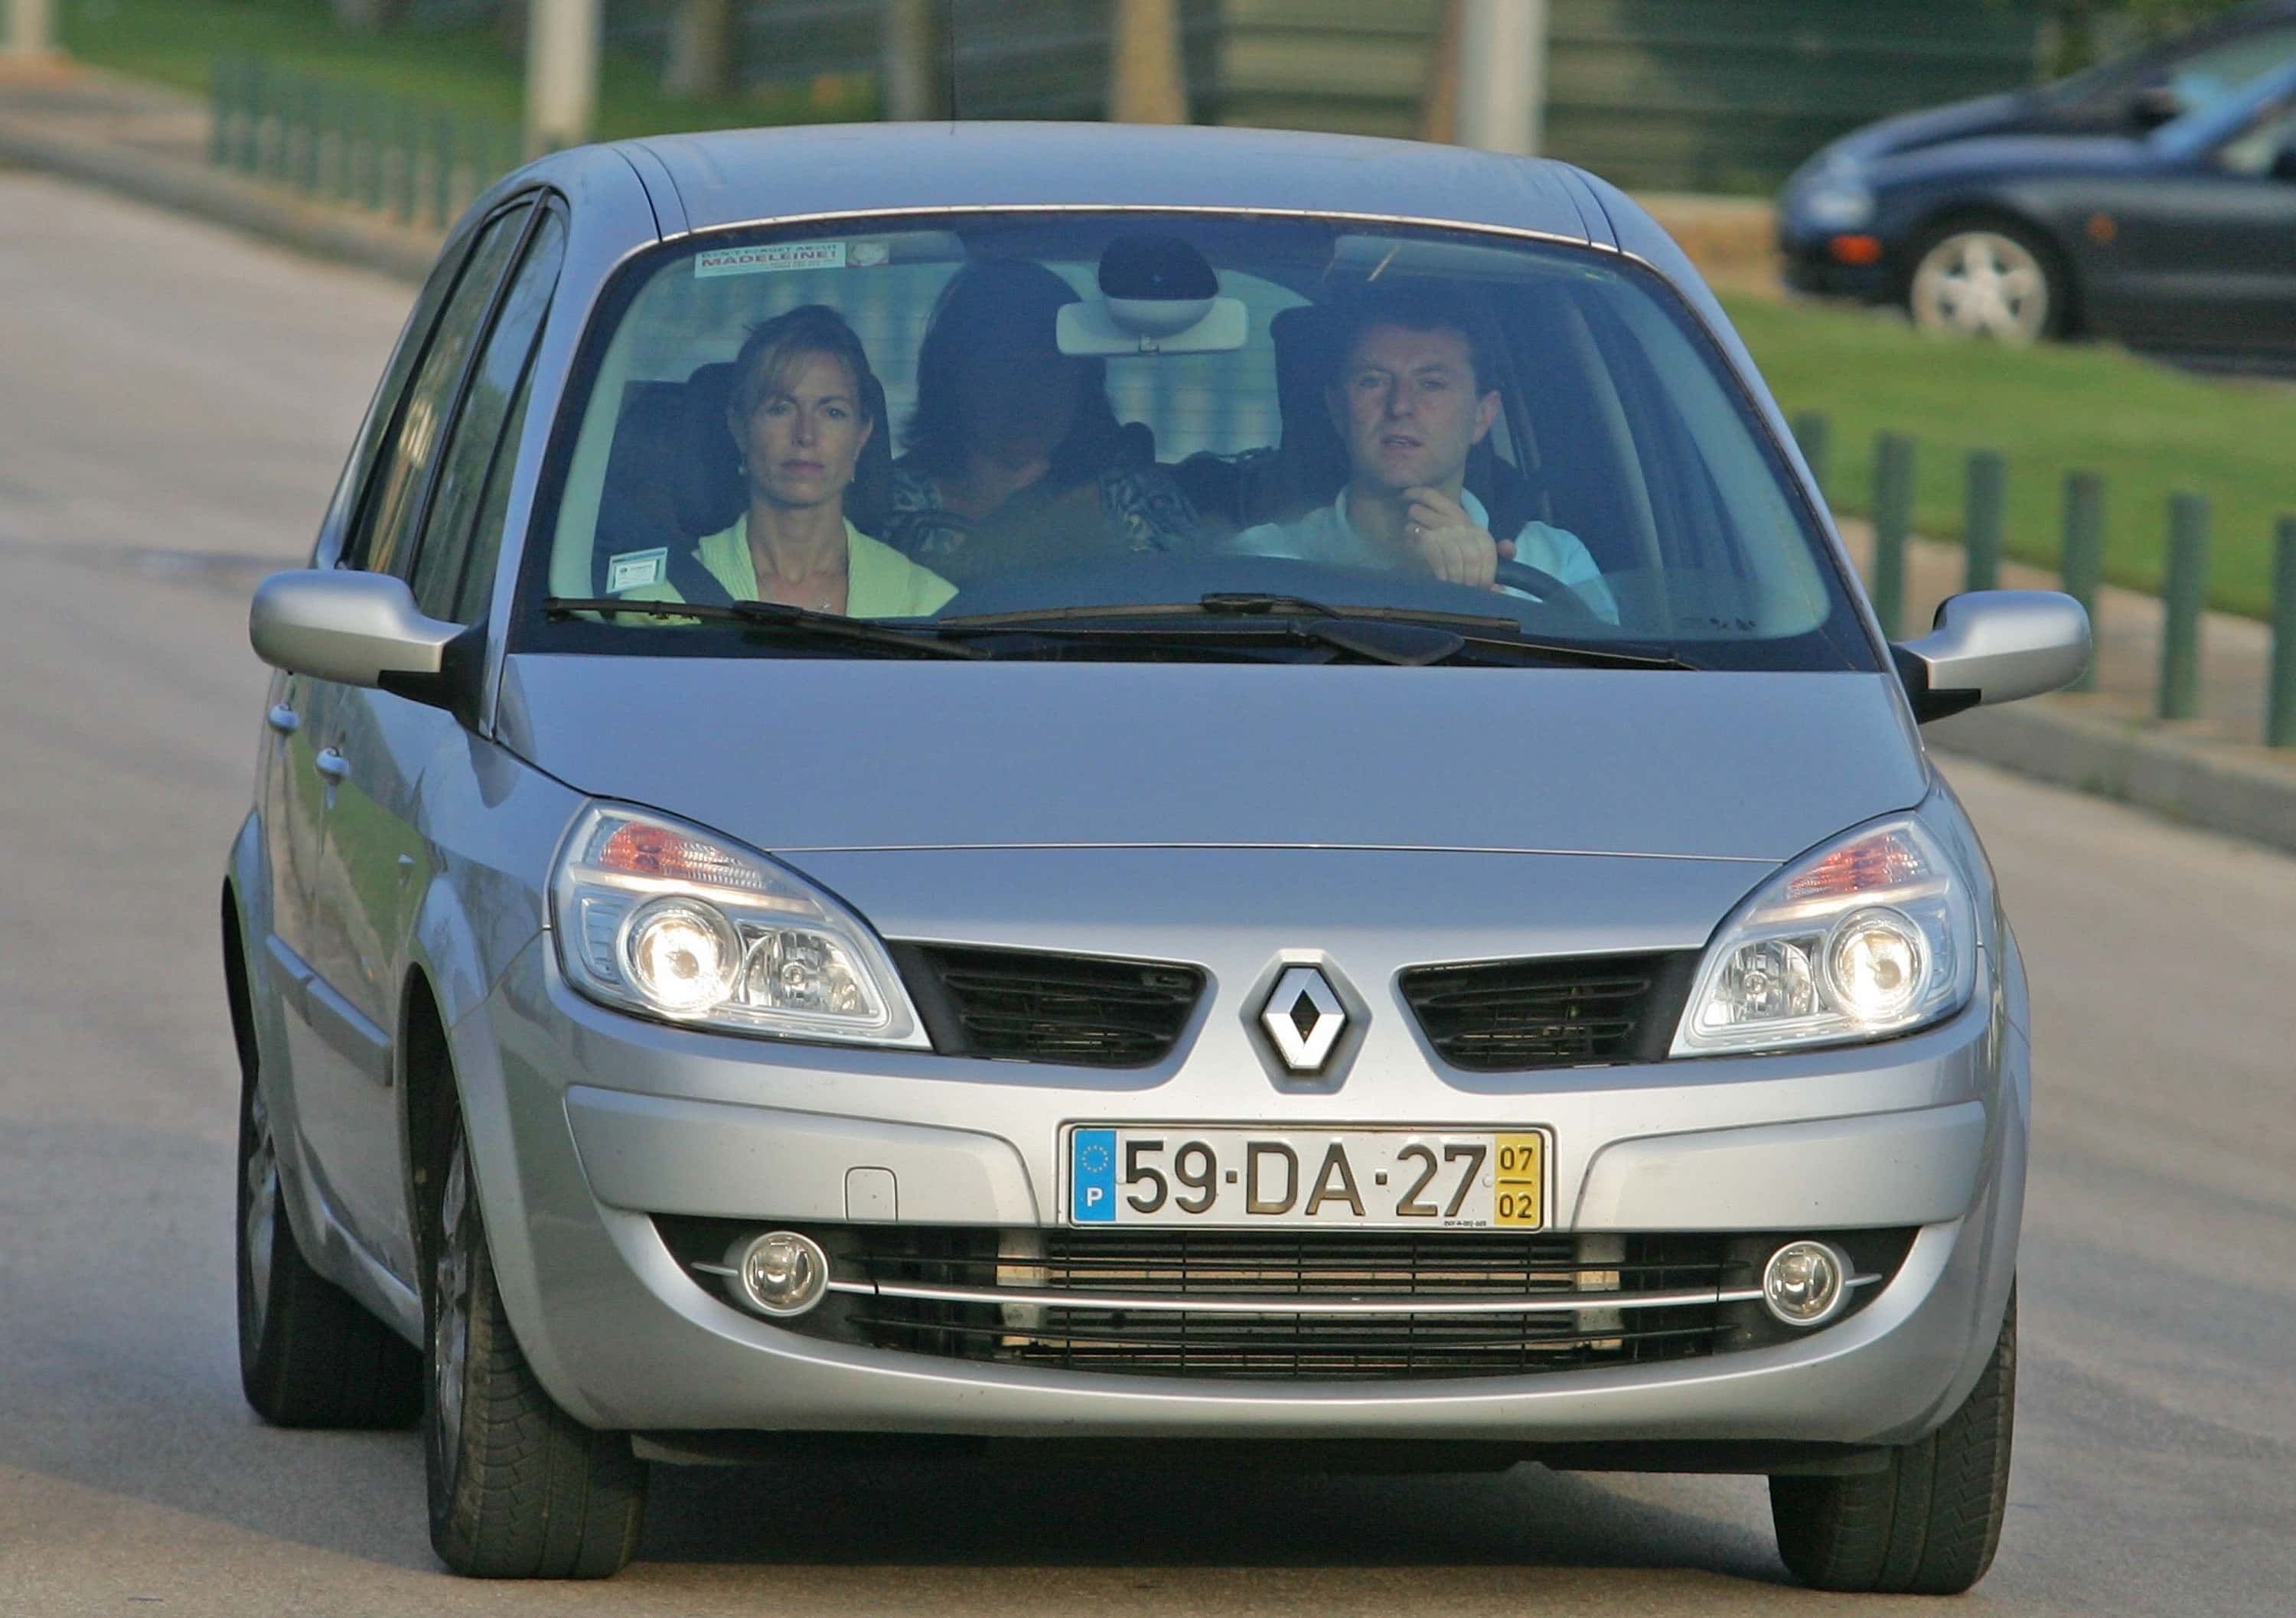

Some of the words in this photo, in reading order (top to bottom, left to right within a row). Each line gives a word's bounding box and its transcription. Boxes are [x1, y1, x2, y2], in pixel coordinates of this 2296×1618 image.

[1500, 1146, 1532, 1171] 07
[1087, 1186, 1103, 1207] P
[1499, 1193, 1532, 1218] 02
